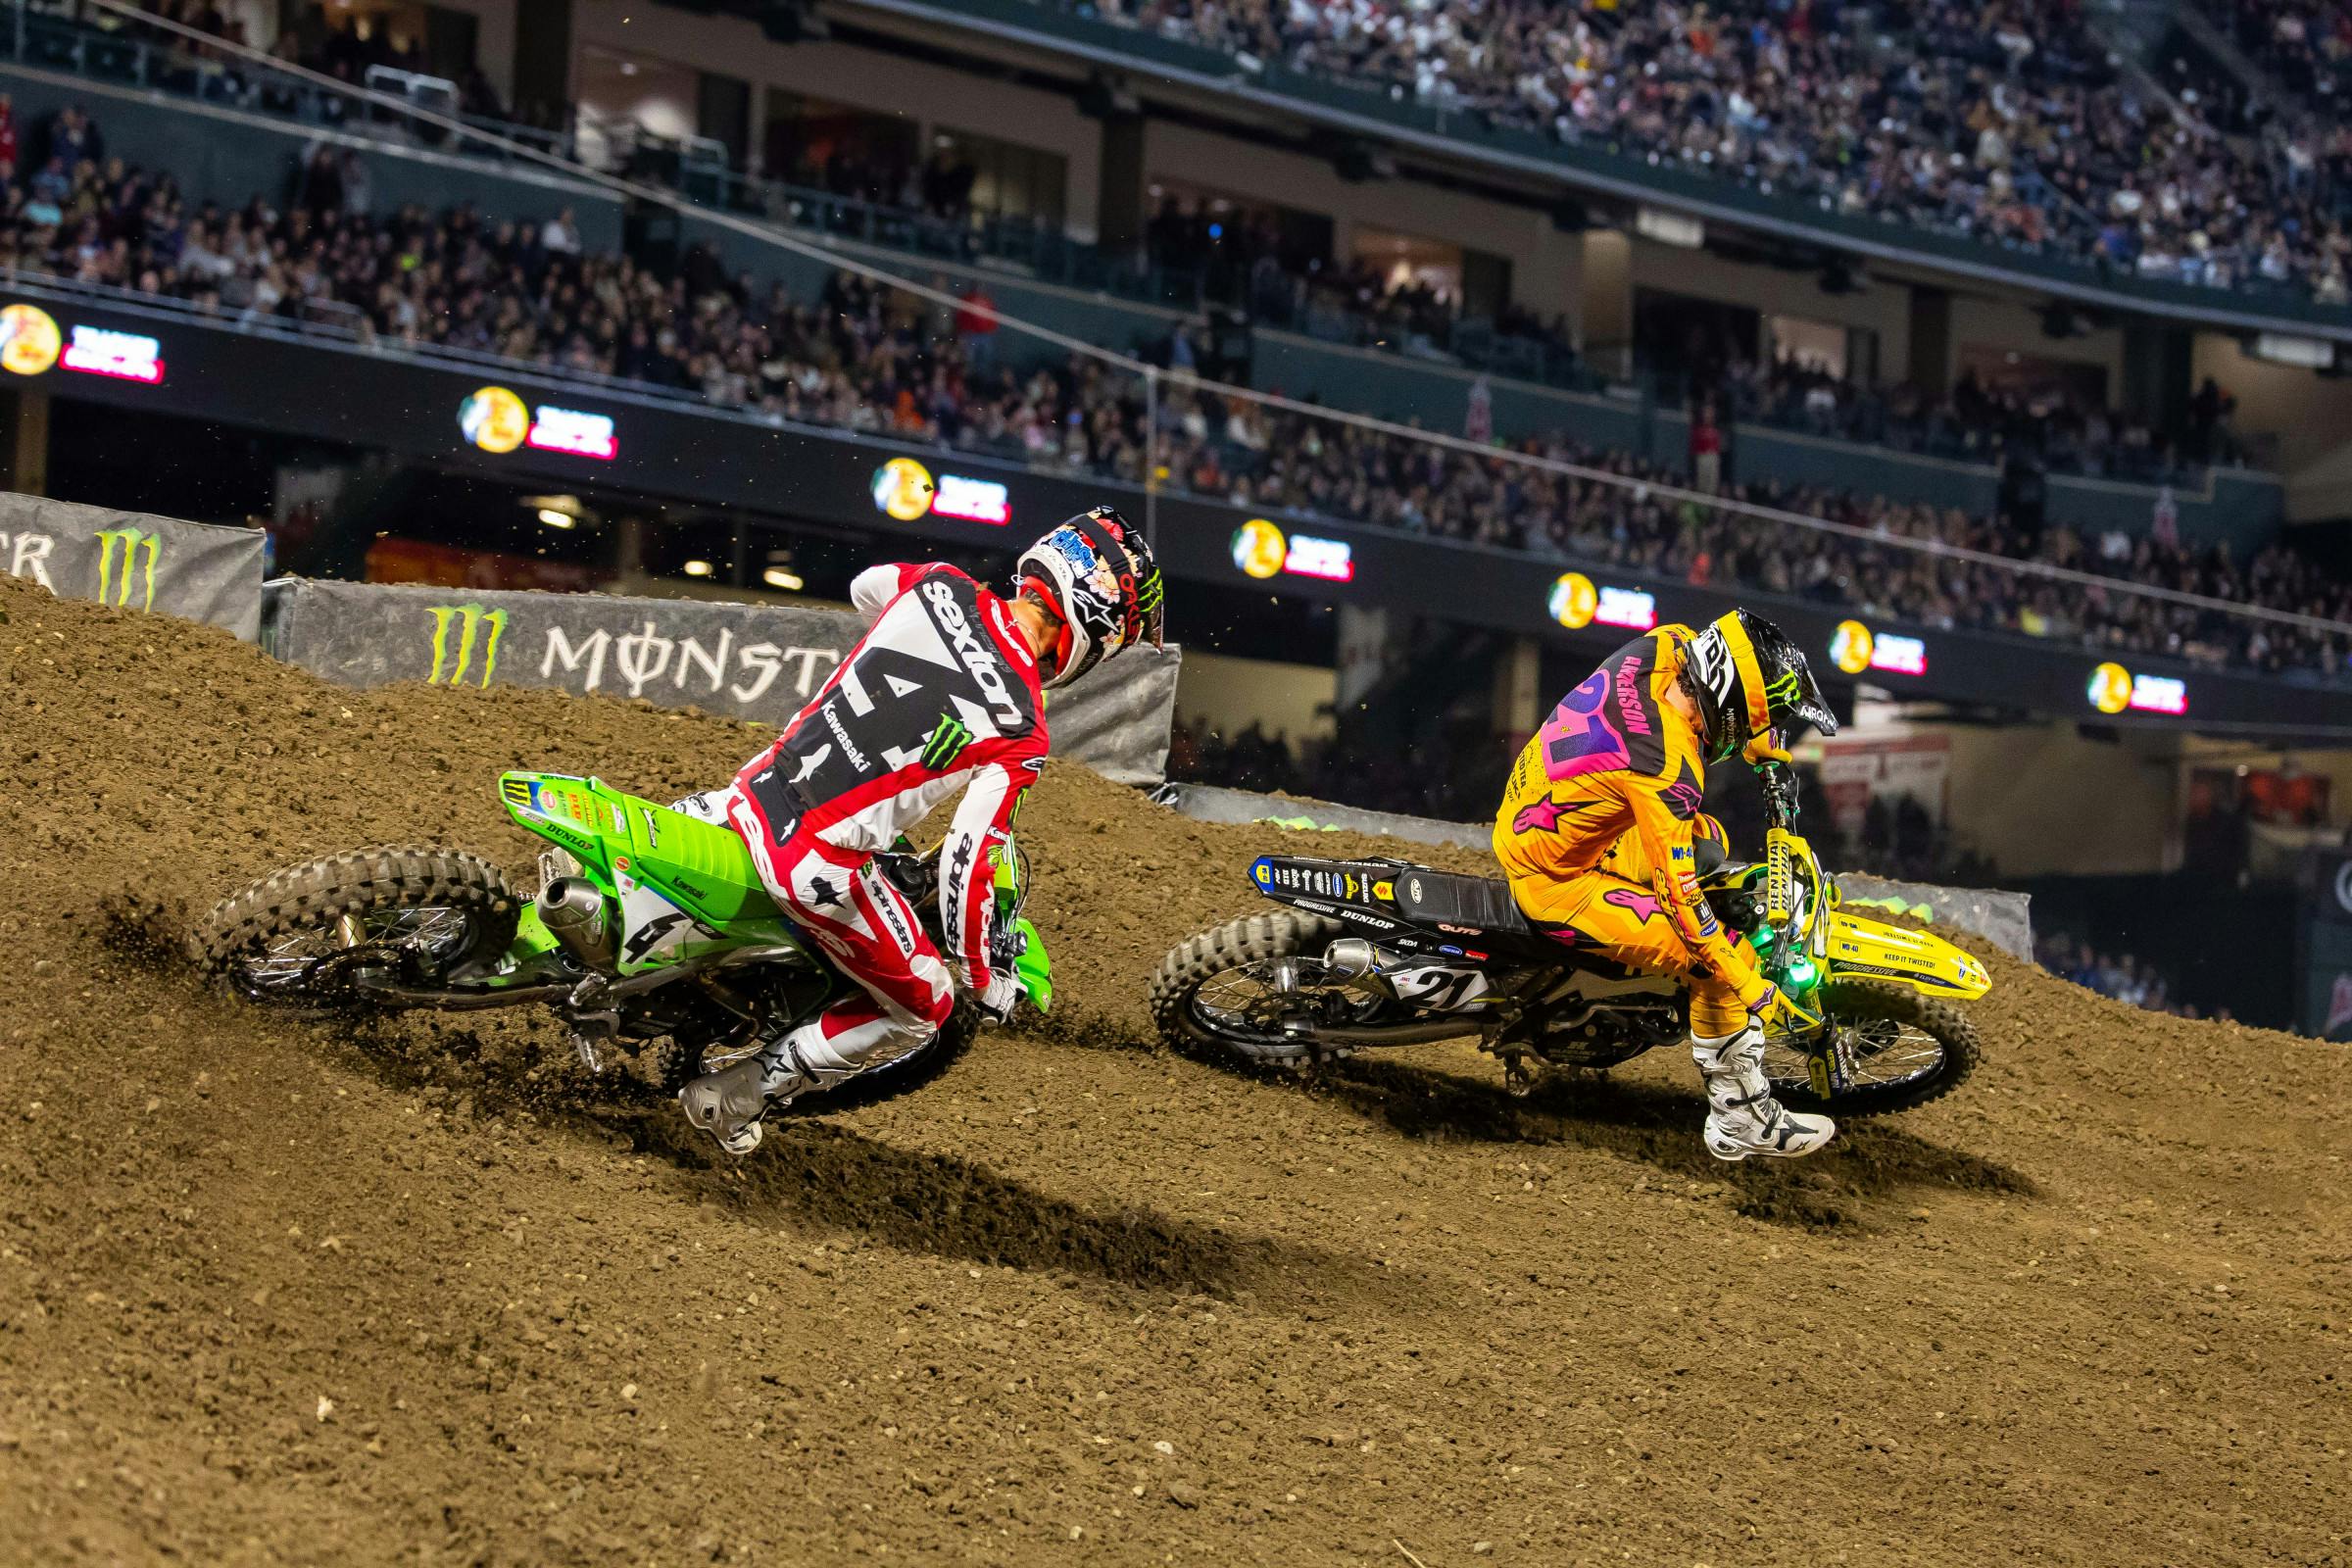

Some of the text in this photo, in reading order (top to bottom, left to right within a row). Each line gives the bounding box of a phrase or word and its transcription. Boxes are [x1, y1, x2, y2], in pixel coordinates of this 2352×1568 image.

[1050, 529, 1097, 569] CHASE
[539, 620, 840, 703] MONST
[922, 580, 1022, 725] sexton
[1616, 656, 1651, 736] ANDERSON
[821, 700, 872, 773] Kawasaki
[546, 823, 595, 851] DUNLOP
[870, 880, 912, 953] alpinestars
[1293, 899, 1337, 913] PROGRESSIVE
[1341, 909, 1395, 929] DUNLOP
[624, 912, 688, 964] 4
[1397, 938, 1418, 948] SKDA
[1834, 960, 1900, 977] PROGRESSIVE
[1884, 953, 1899, 961] KEEP
[1908, 957, 1936, 969] TWISTED!
[1406, 970, 1477, 1009] 21
